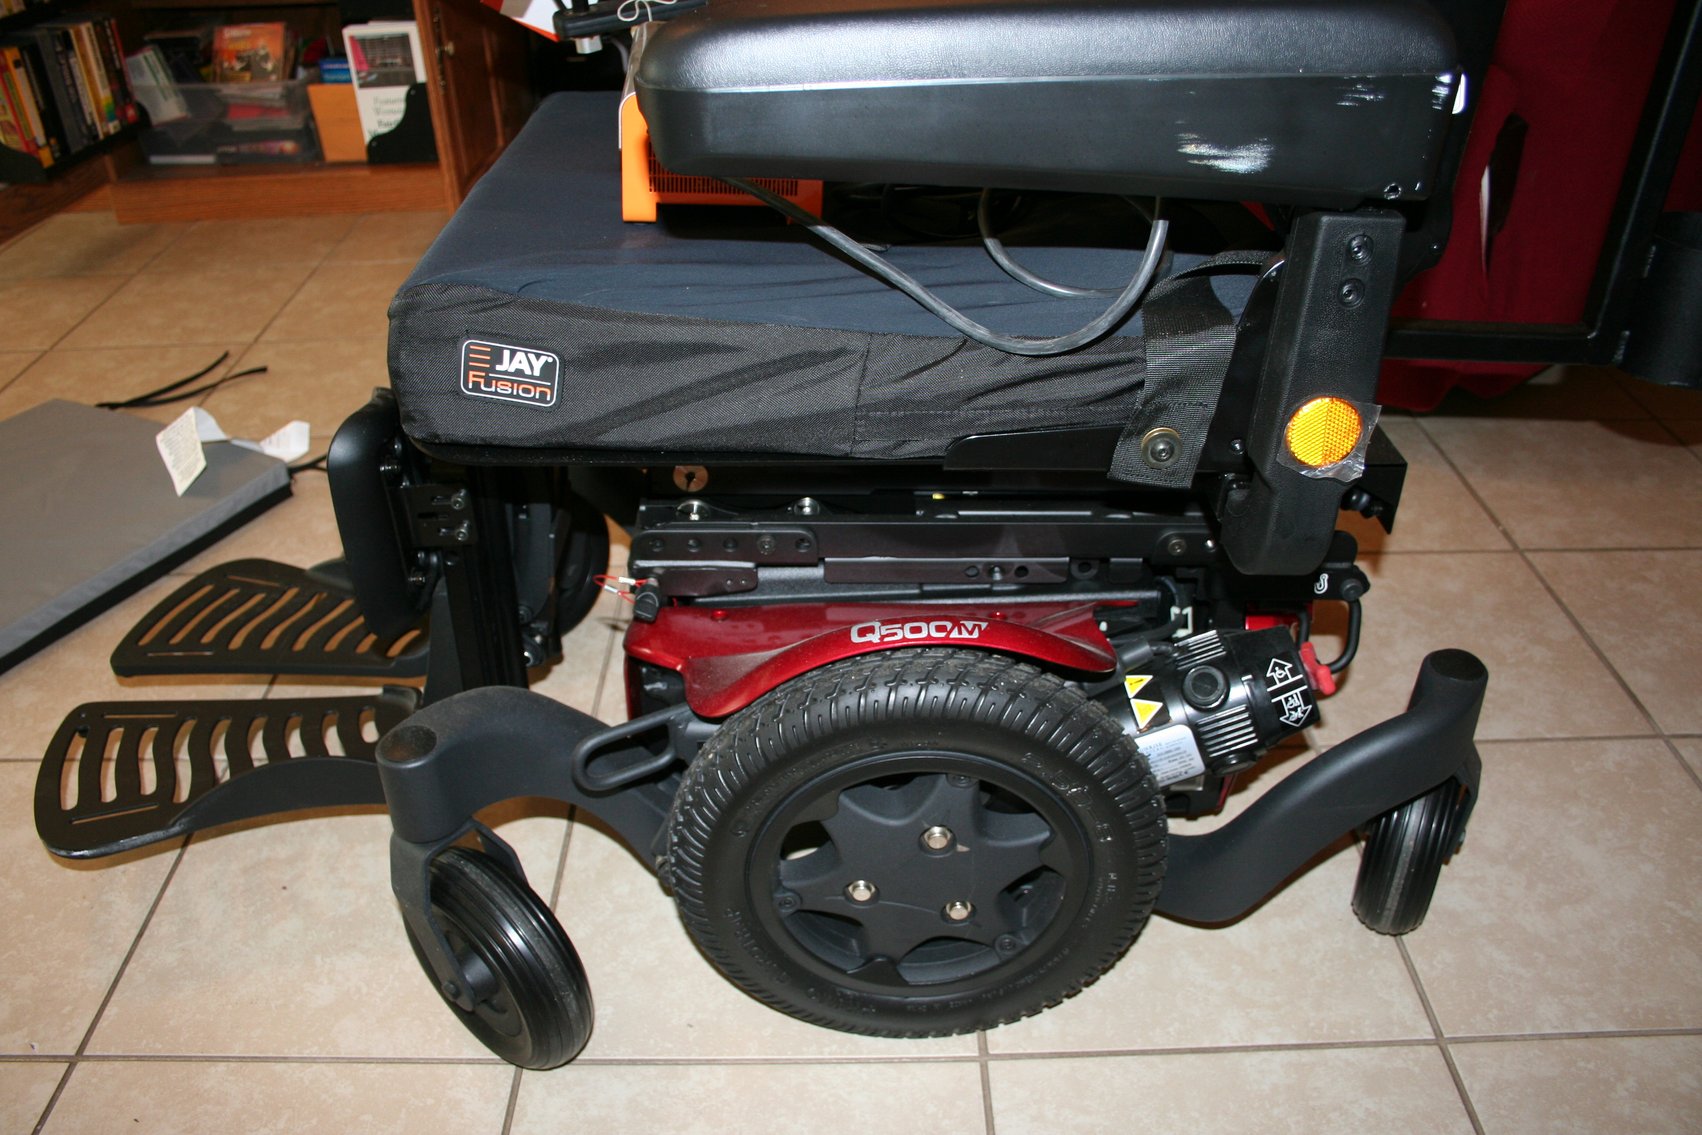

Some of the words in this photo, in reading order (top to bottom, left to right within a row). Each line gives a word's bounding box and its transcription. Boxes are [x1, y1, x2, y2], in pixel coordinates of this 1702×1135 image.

[495, 349, 549, 377] JAY
[468, 370, 552, 401] Fusion
[850, 621, 989, 644] Q500M
